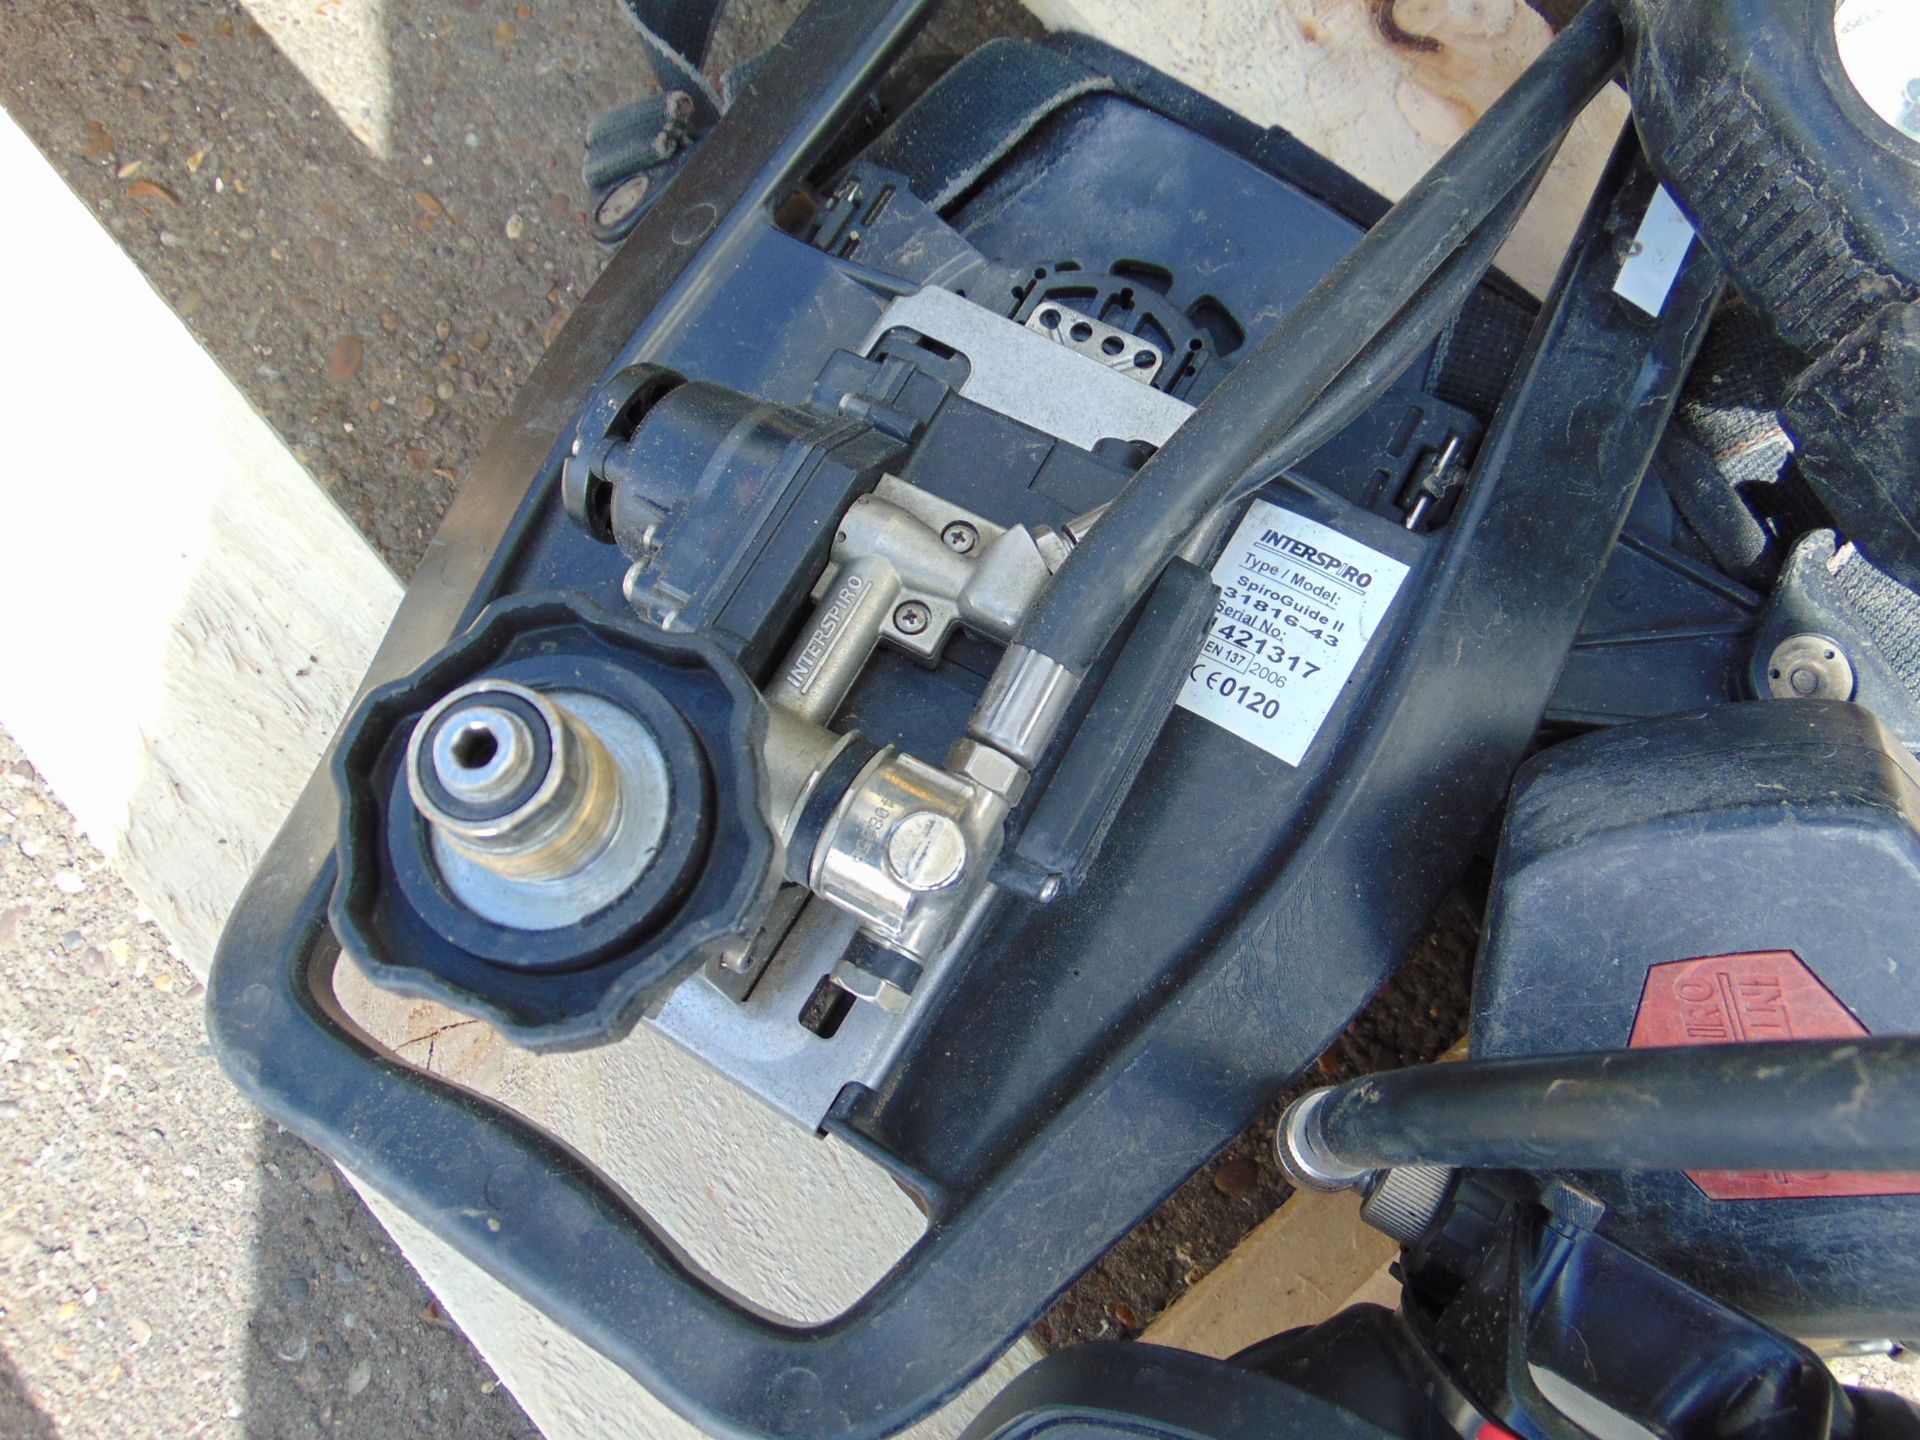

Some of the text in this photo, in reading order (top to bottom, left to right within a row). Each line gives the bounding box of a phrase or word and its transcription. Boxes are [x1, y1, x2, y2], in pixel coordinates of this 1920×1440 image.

[1244, 551, 1279, 577] Type
[1290, 572, 1341, 607] Model:
[1260, 528, 1373, 588] INTERSPIRO
[1216, 599, 1259, 628] Serial
[1223, 586, 1340, 648] 31816-43
[1237, 575, 1329, 625] SpiroGuide
[786, 575, 862, 688] INTERSPIRO
[1204, 640, 1288, 689] EN 137 2006
[1218, 677, 1281, 719] 0120
